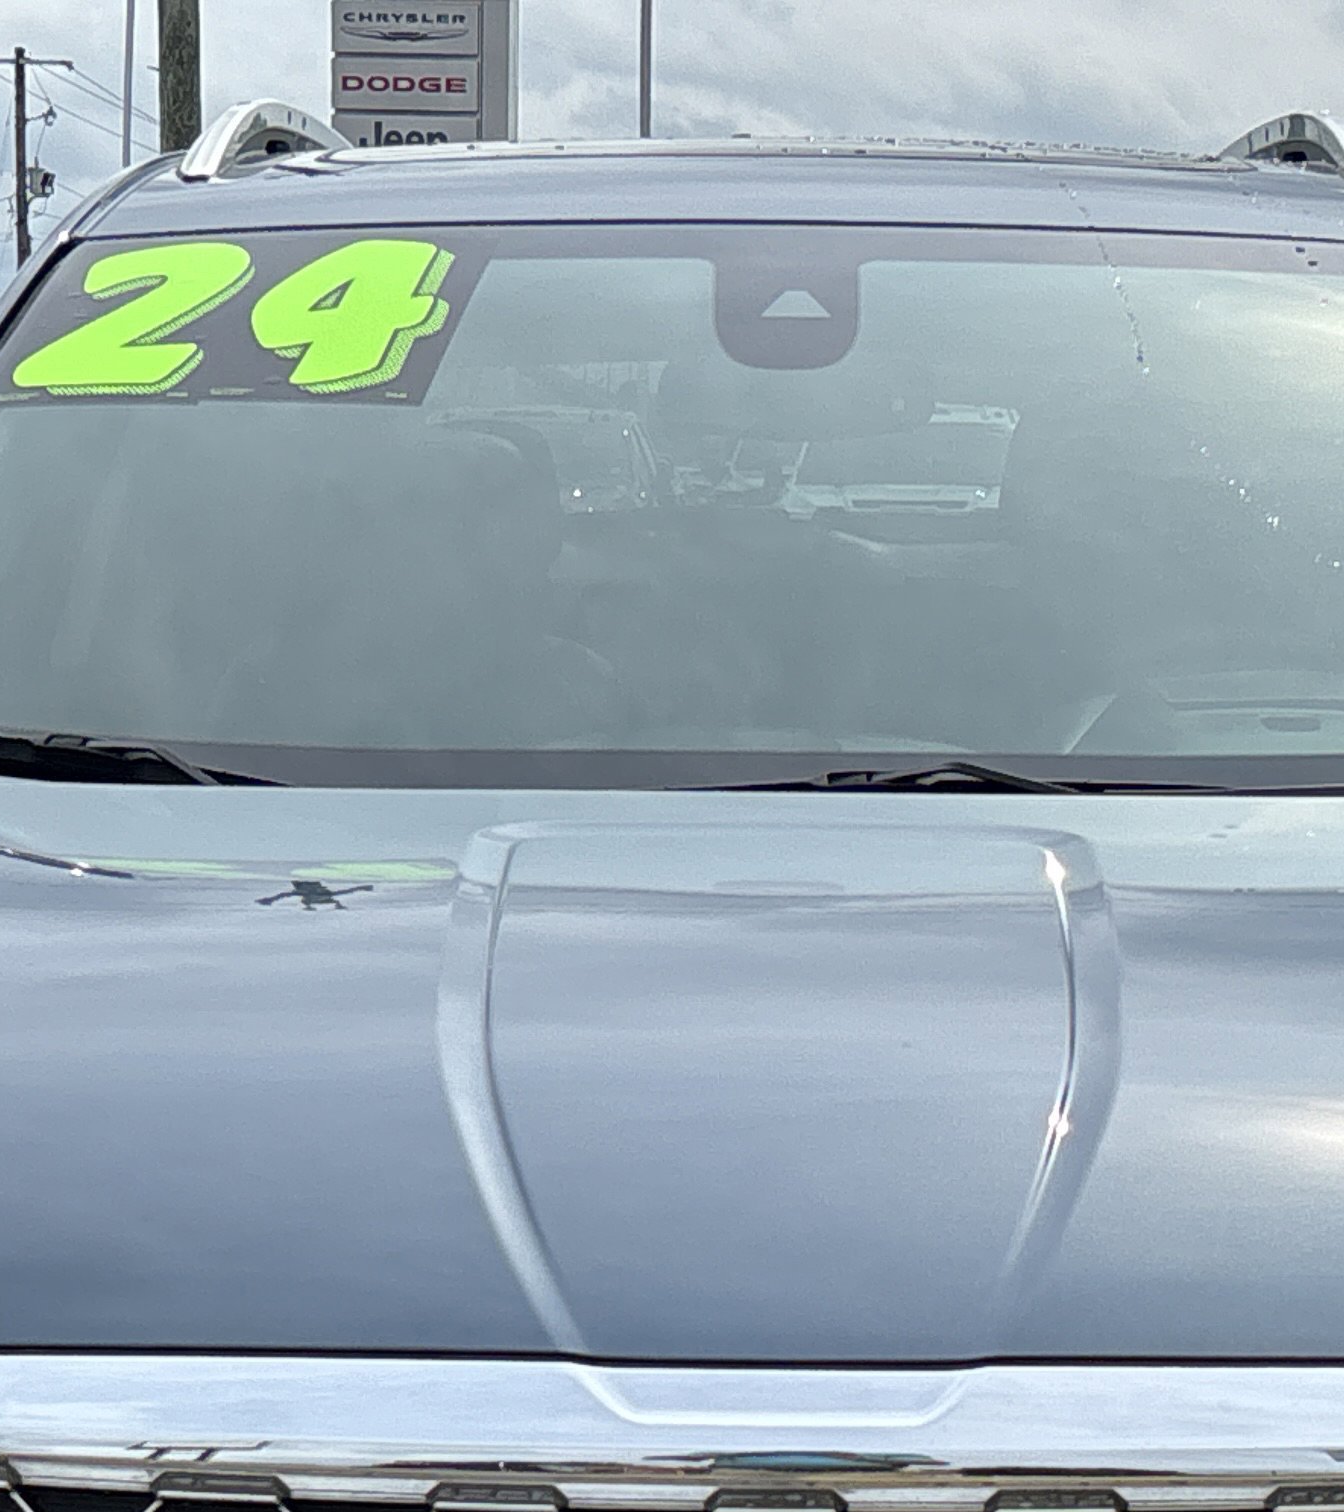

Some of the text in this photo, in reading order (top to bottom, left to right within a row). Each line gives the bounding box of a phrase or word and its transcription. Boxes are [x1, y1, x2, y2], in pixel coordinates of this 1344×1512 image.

[343, 12, 466, 24] CHRYSLER
[341, 75, 467, 93] DODGE
[13, 239, 455, 394] 24
